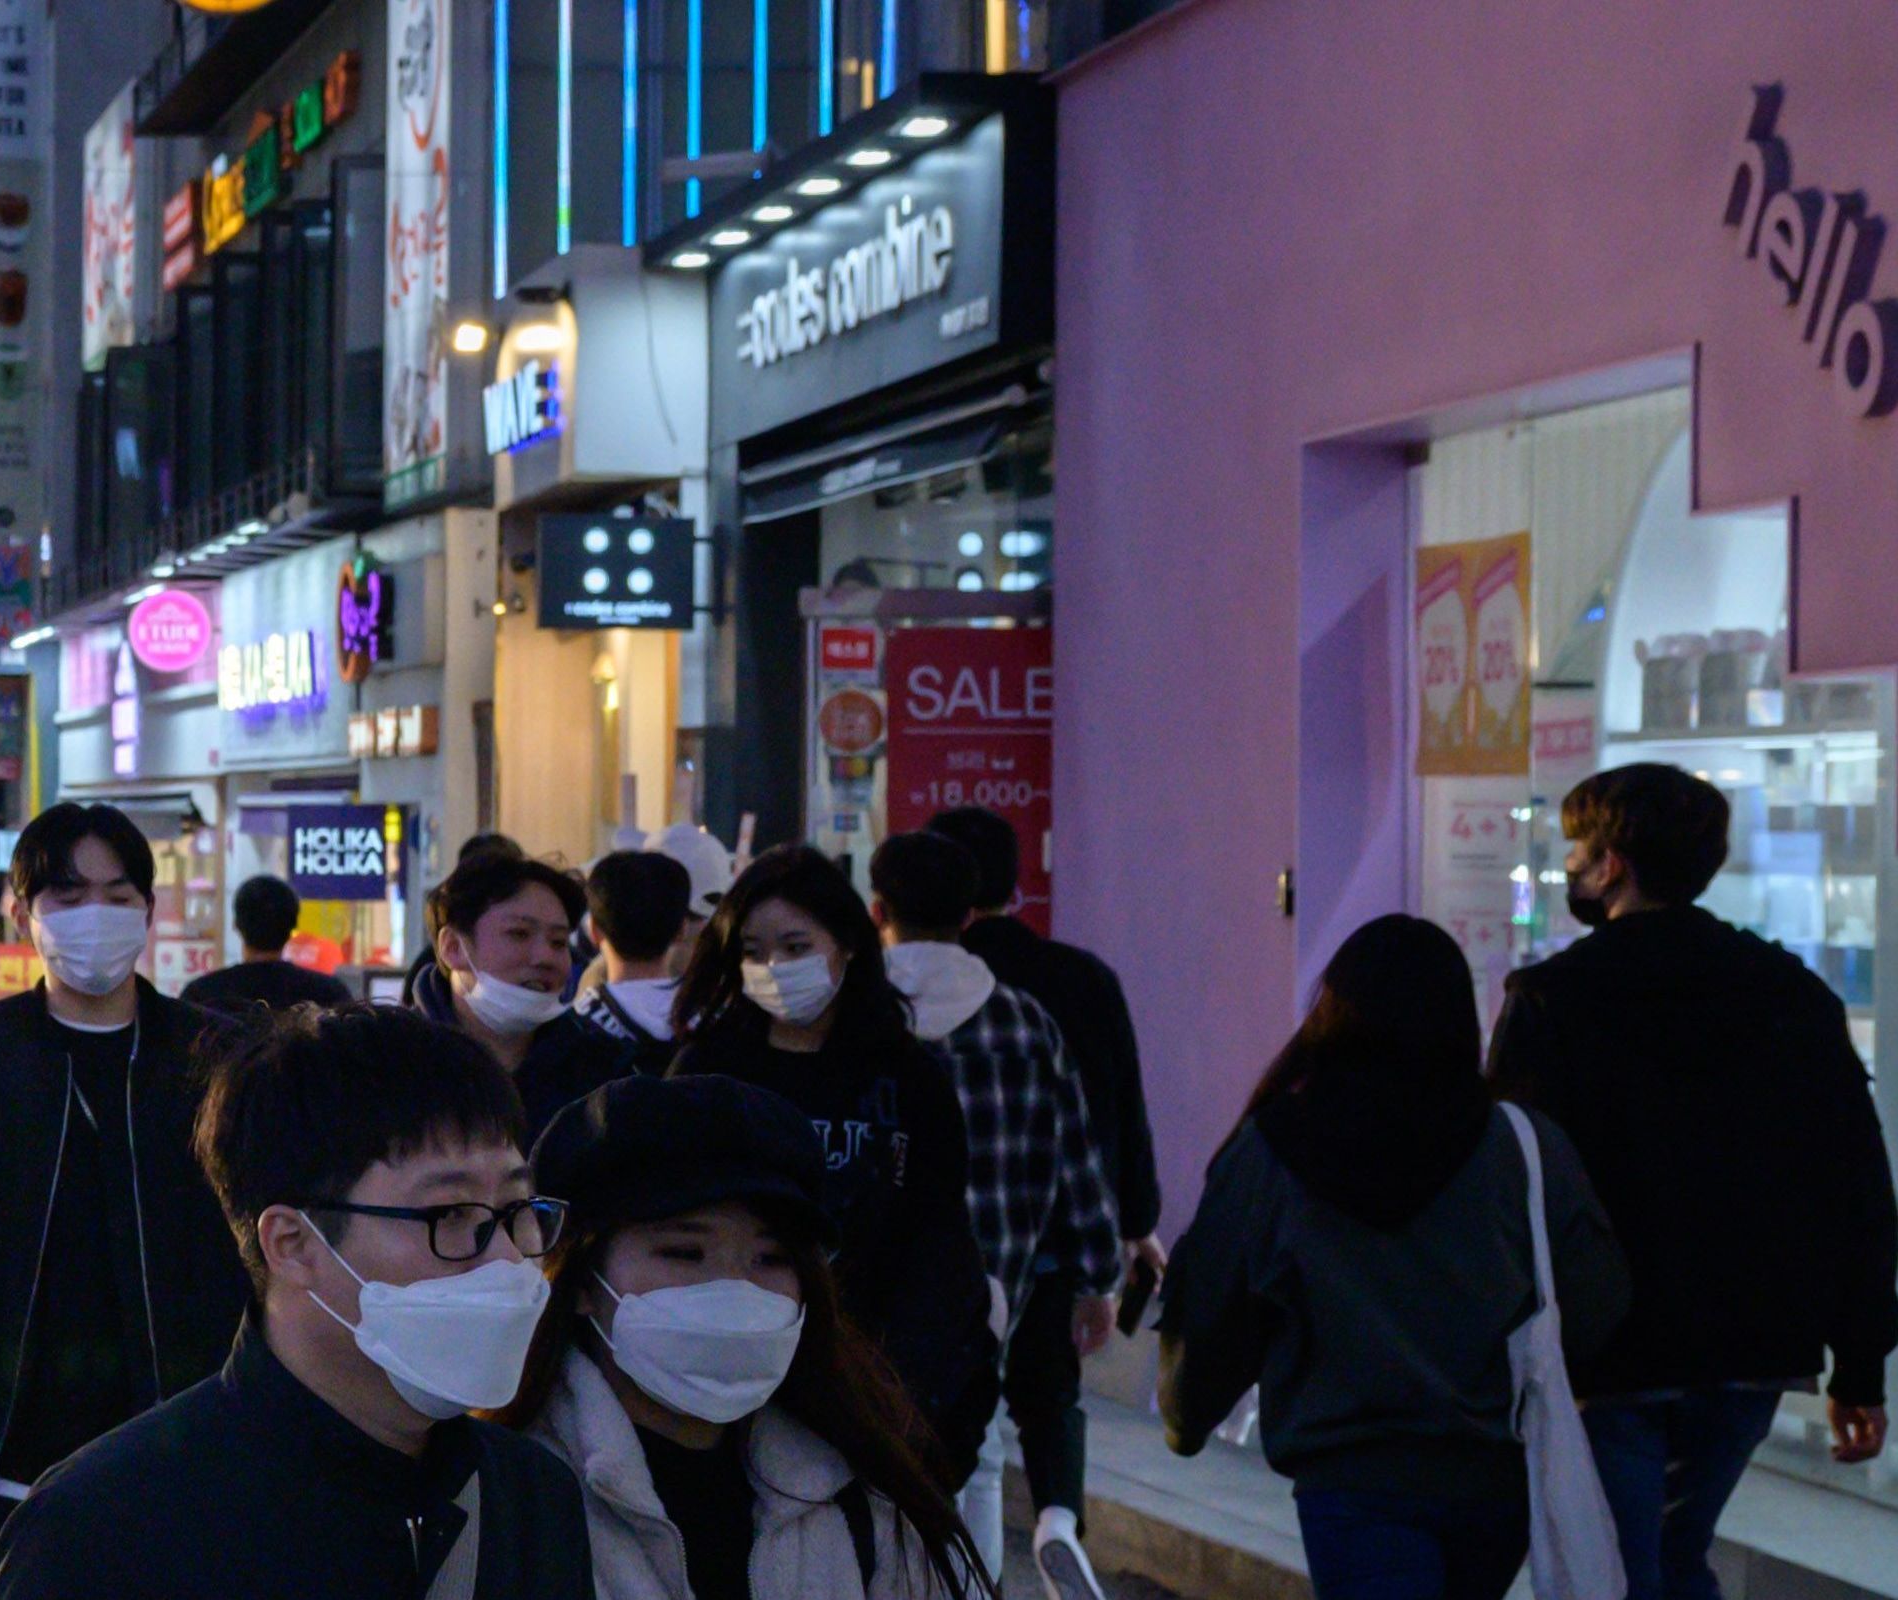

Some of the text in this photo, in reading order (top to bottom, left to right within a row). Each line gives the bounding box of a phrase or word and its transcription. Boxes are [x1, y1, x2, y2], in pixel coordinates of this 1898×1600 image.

[828, 193, 954, 336] combine
[905, 664, 1054, 722] SALE
[294, 826, 384, 853] HOLIKA
[294, 851, 384, 876] HOLIKA
